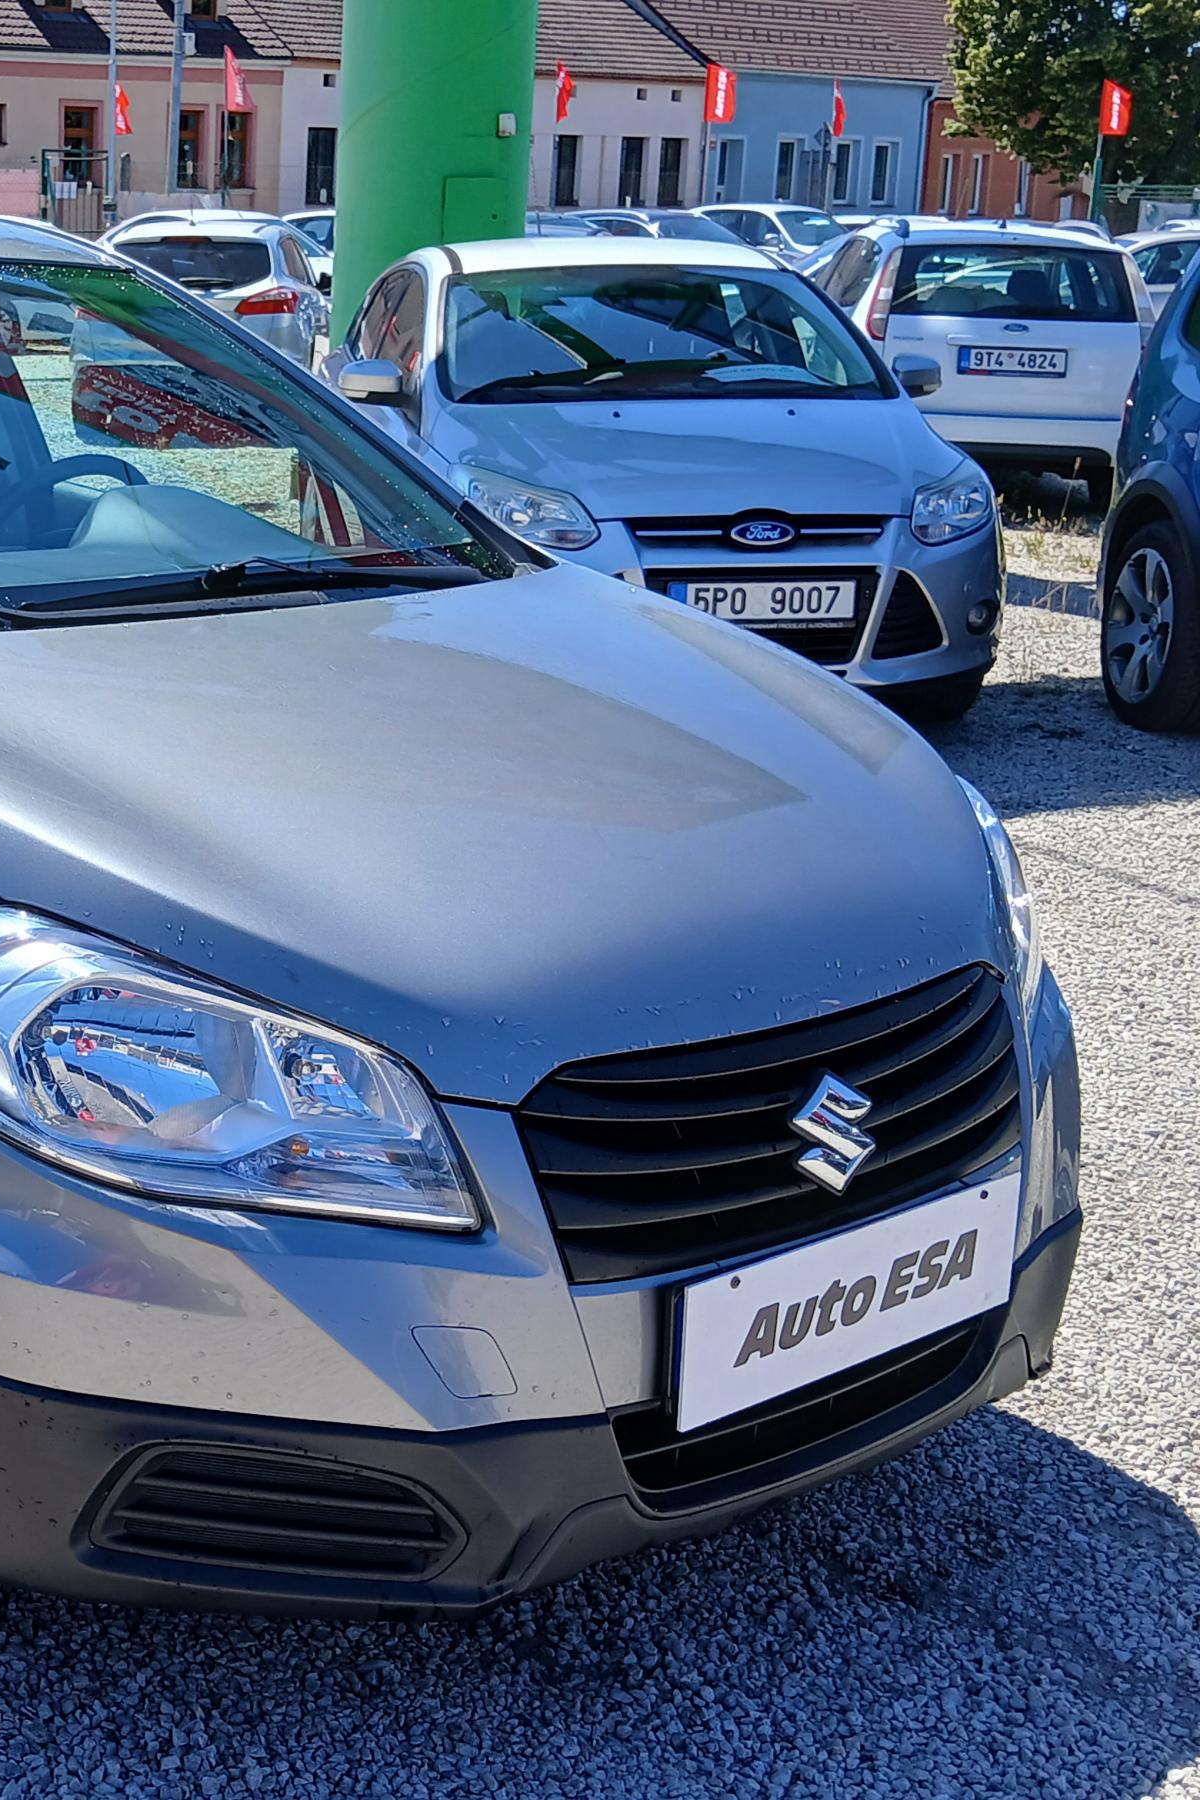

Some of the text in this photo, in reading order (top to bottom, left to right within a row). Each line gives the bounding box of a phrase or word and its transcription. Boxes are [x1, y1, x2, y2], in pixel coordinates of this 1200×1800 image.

[715, 91, 725, 118] Auto
[973, 351, 1004, 368] 9T4
[1016, 352, 1058, 370] 4824
[746, 524, 781, 539] Ford
[771, 586, 840, 614] 9007
[732, 1228, 979, 1369] Auto ESA
